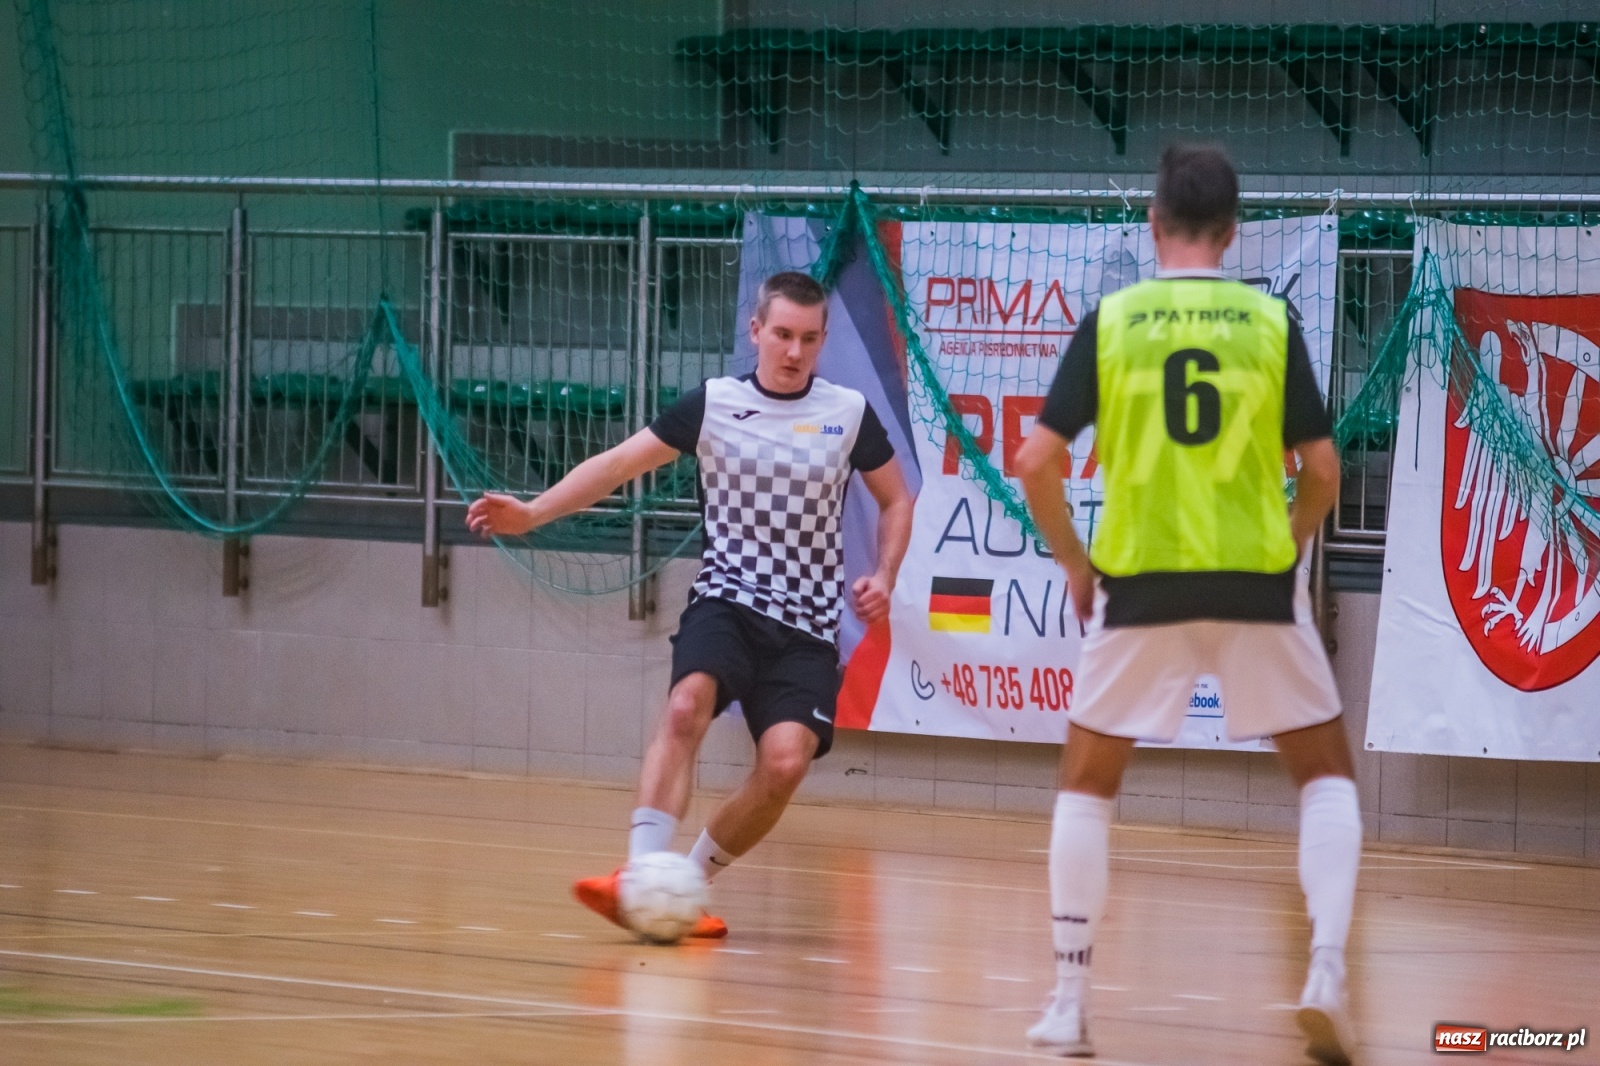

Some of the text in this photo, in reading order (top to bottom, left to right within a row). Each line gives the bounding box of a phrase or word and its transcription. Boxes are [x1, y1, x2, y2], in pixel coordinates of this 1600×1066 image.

[925, 277, 1077, 326] PRIMA
[1153, 305, 1252, 326] PATRICK
[1164, 348, 1221, 447] 6
[941, 663, 1074, 712] +48 735 408
